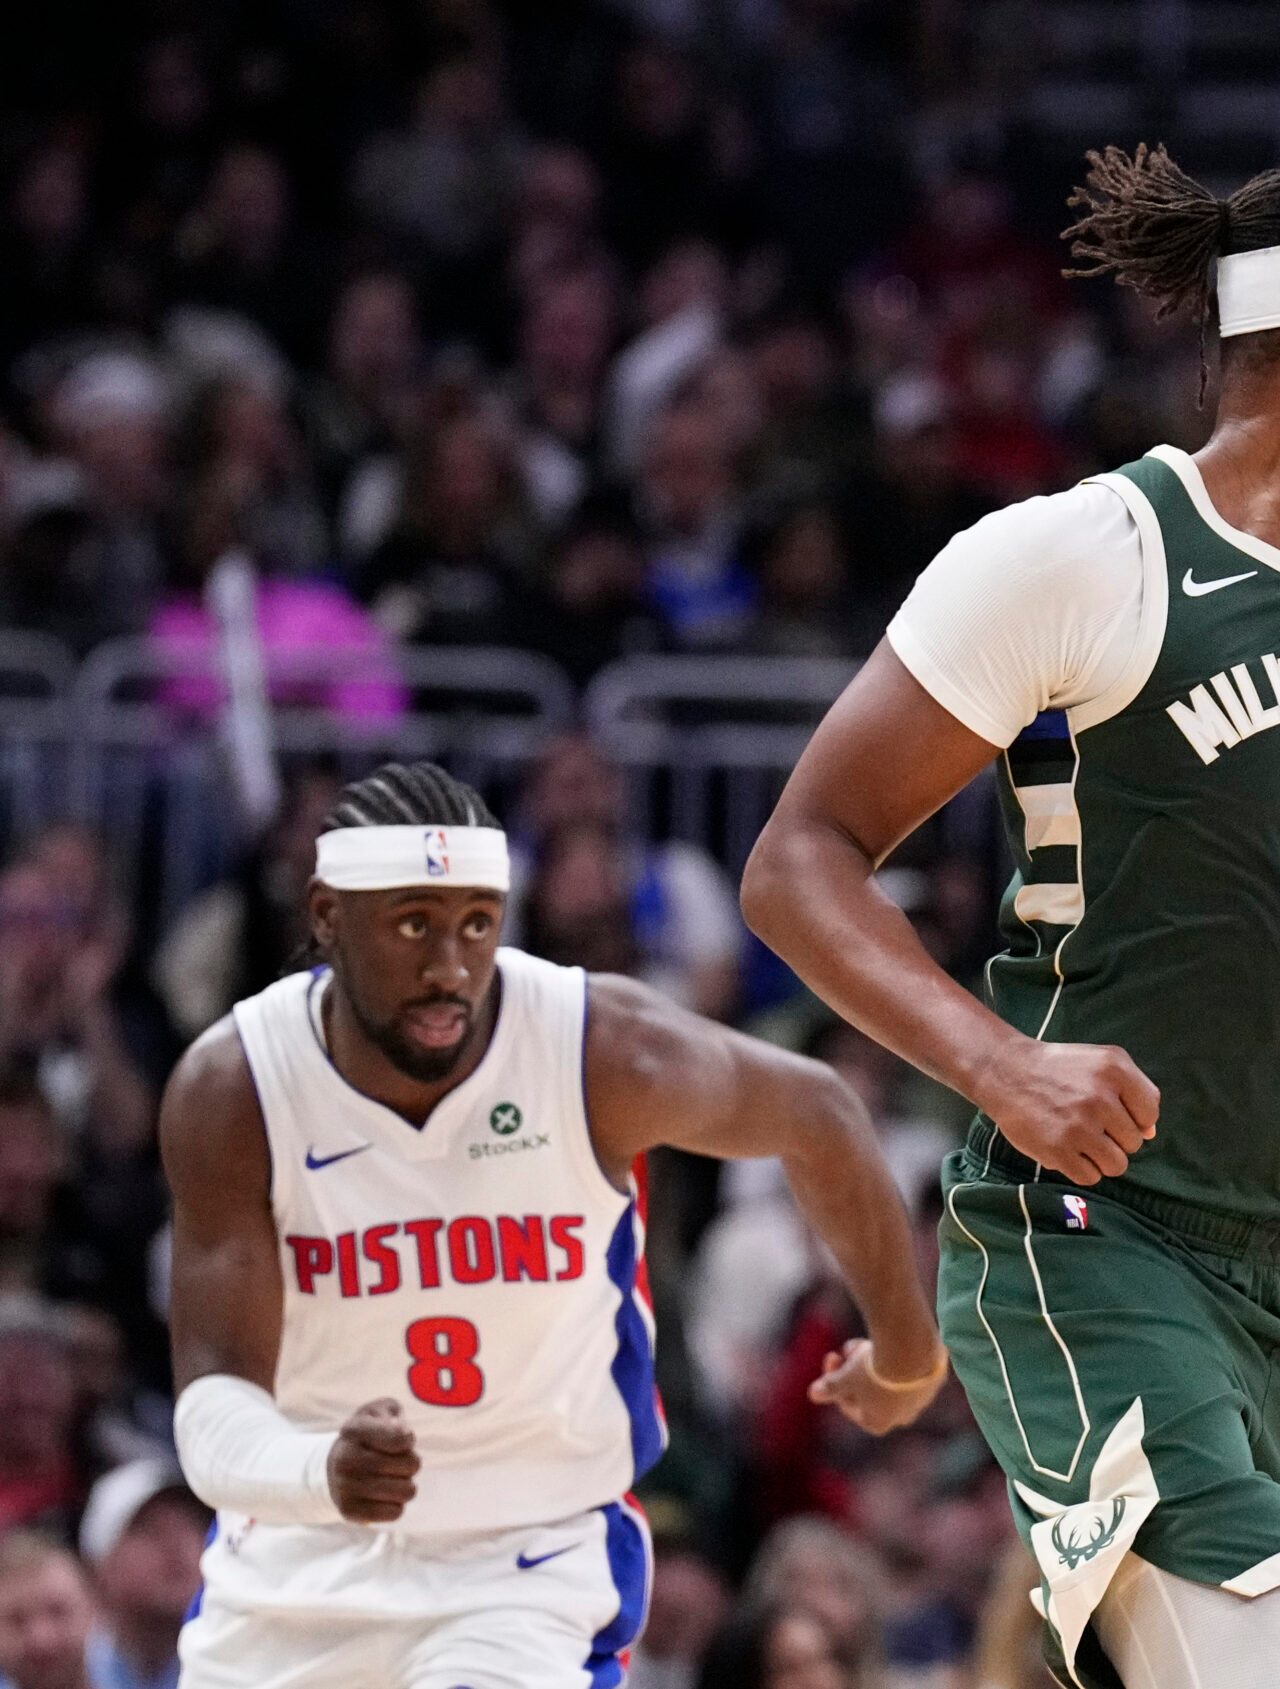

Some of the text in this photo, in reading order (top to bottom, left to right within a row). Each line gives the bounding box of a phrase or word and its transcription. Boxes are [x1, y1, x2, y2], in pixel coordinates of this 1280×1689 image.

[468, 1132, 551, 1160] StockX
[285, 1213, 587, 1298] PISTONS
[405, 1314, 485, 1408] 8
